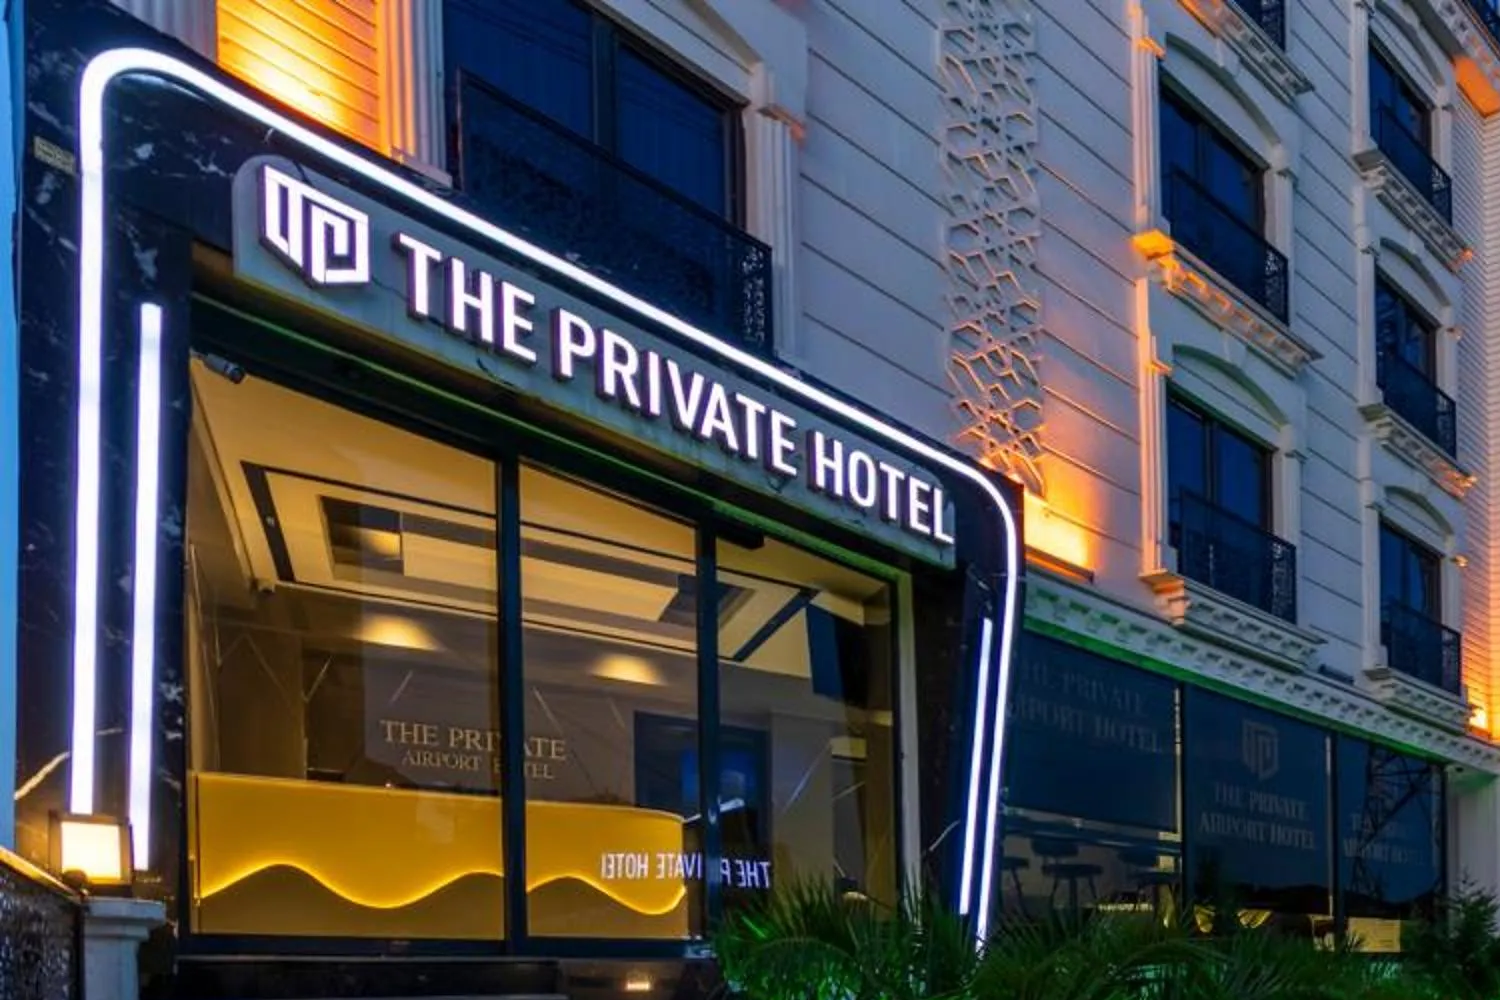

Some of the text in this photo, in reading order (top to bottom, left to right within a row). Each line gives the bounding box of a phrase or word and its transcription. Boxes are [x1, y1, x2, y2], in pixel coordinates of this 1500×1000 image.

[394, 231, 956, 546] THE PRIVATE HOTEL
[379, 718, 441, 748] THE
[401, 748, 484, 772] AIRPORT
[1211, 781, 1310, 822] THE PRIVATE
[1199, 810, 1266, 843] AIRPORT
[1269, 822, 1317, 851] HOTEL
